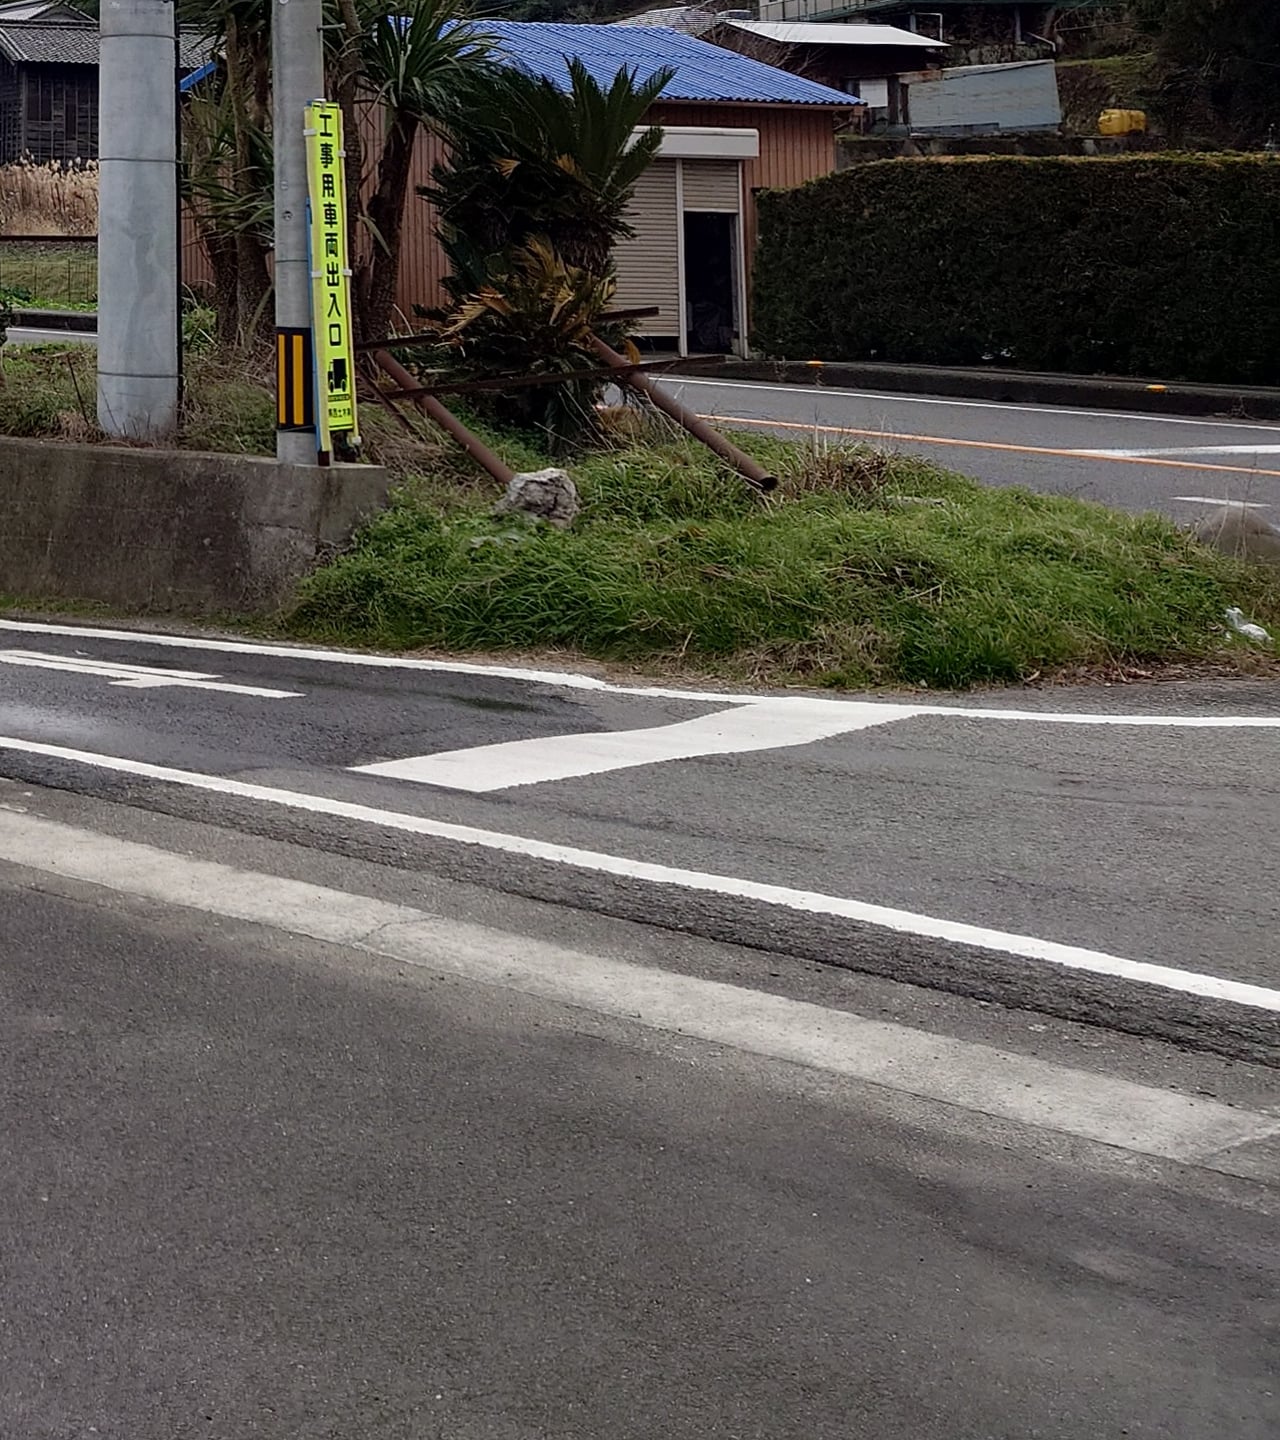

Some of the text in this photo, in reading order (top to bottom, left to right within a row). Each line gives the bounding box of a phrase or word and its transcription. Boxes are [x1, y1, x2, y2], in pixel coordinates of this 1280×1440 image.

[318, 113, 342, 347] 工事用車両出入口
